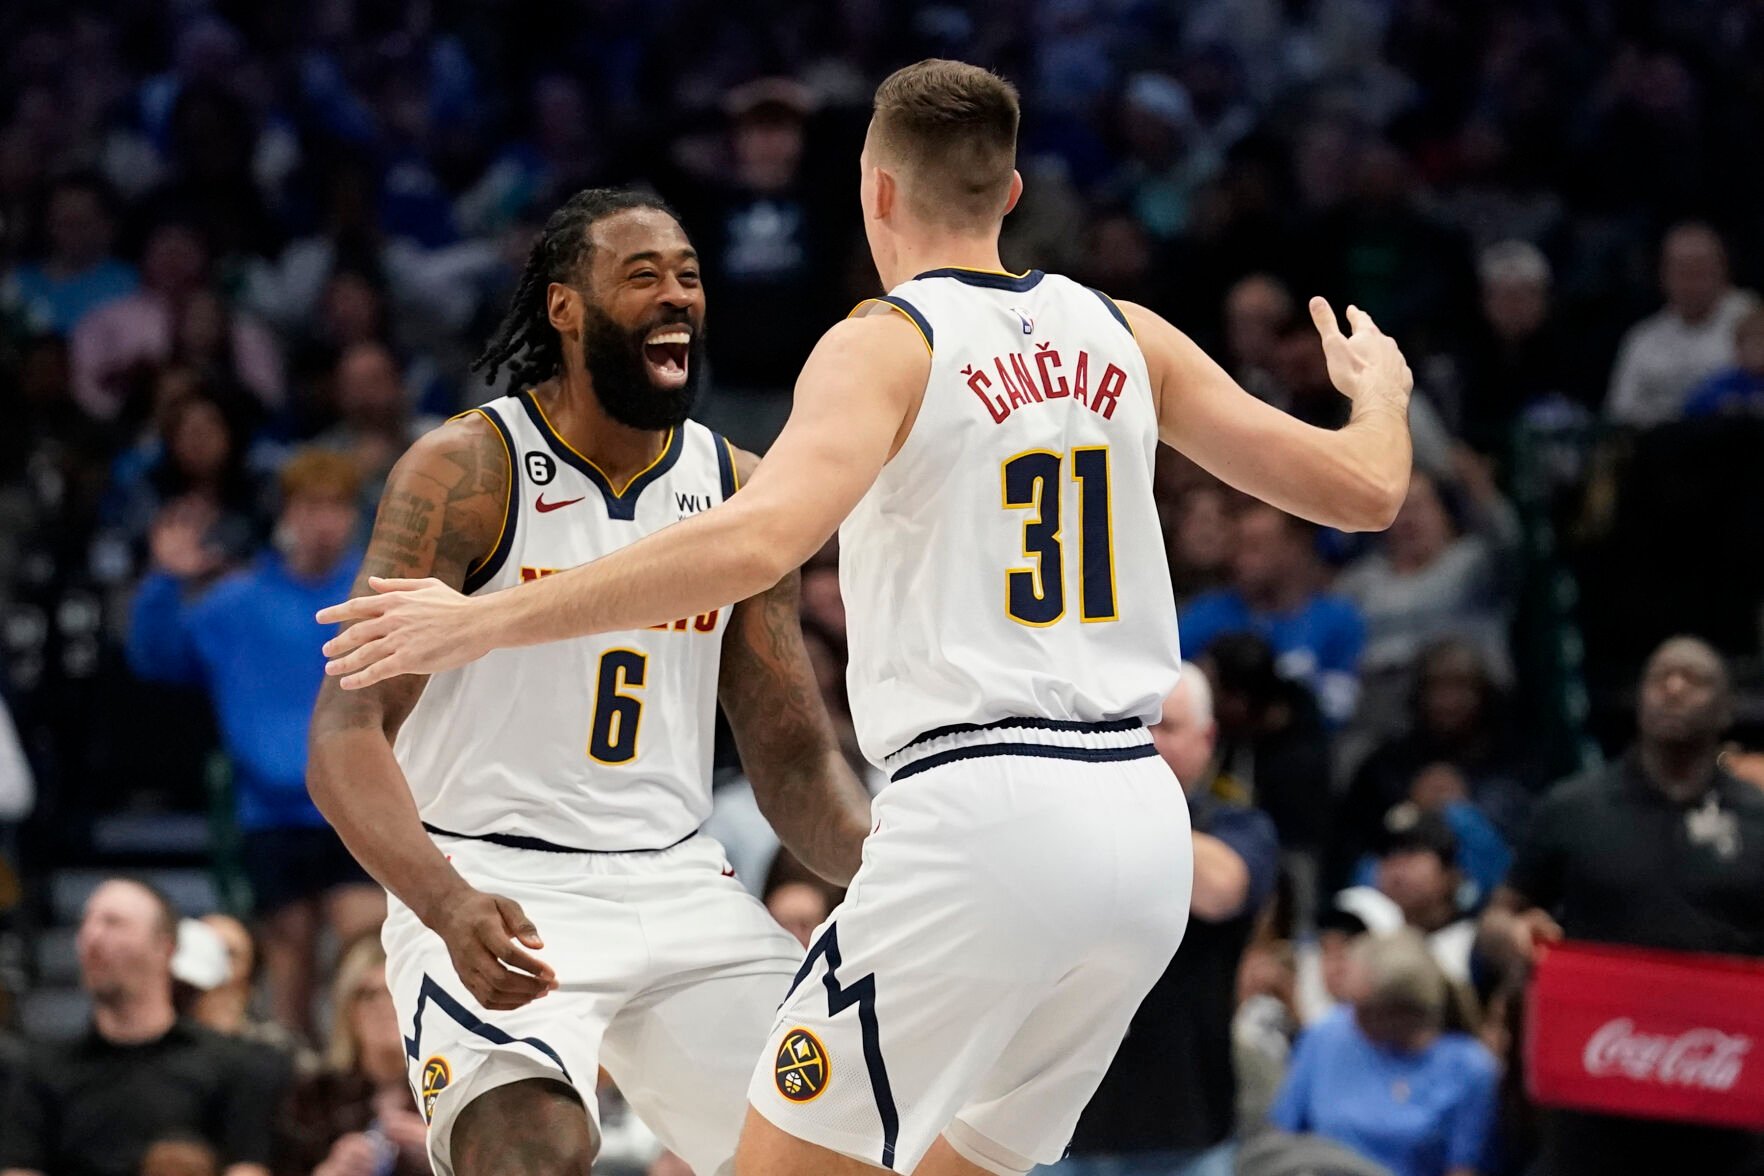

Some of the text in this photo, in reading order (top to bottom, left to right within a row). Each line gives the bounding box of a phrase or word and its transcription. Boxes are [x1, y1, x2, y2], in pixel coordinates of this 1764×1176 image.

[960, 341, 1127, 424] ČANČAR
[528, 455, 549, 482] 6
[1001, 445, 1120, 628] 31
[586, 646, 648, 767] 6
